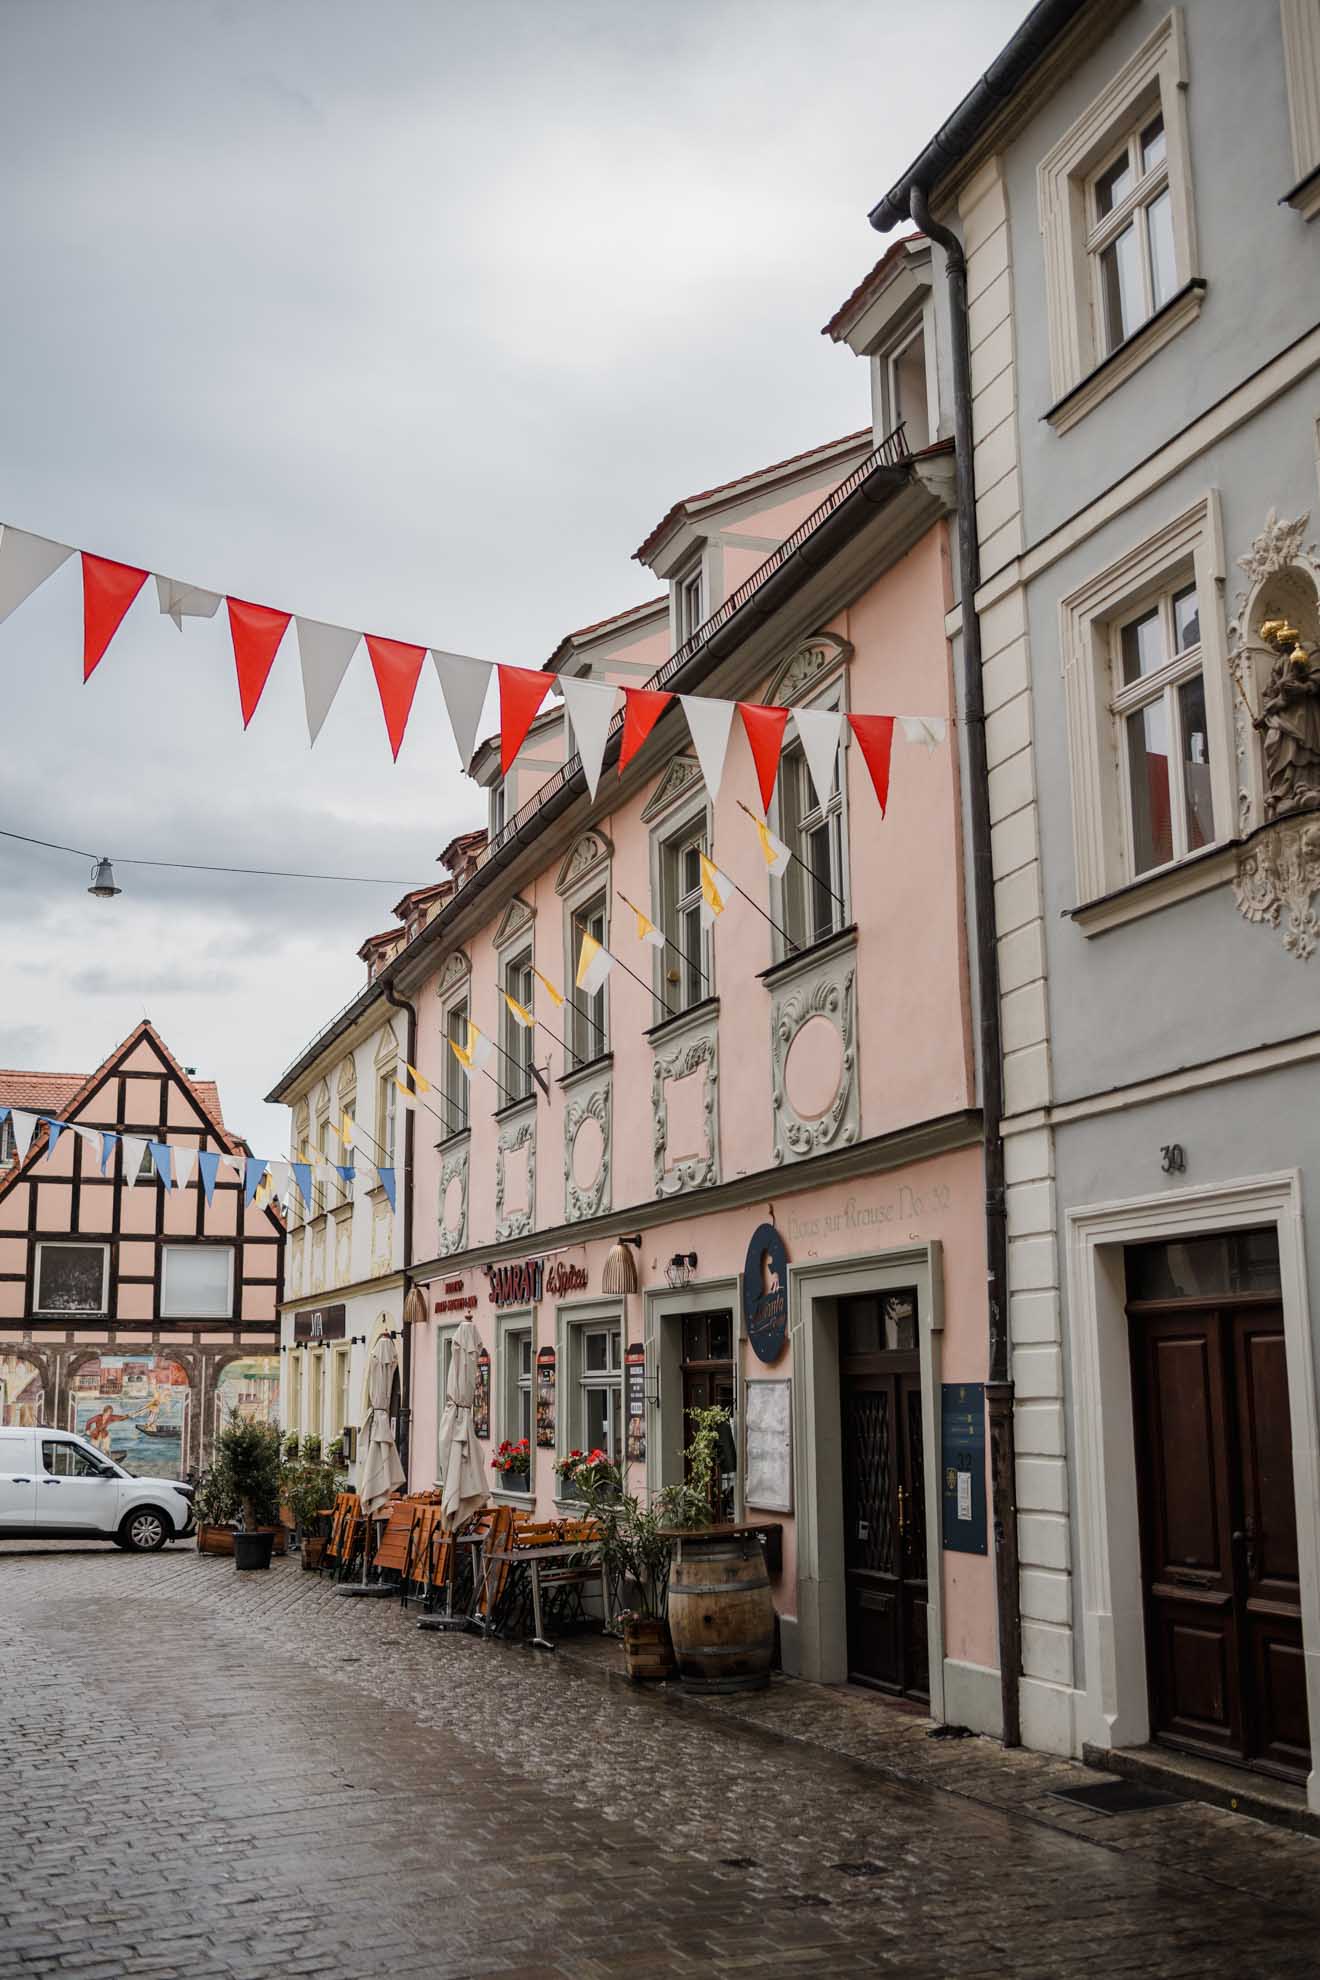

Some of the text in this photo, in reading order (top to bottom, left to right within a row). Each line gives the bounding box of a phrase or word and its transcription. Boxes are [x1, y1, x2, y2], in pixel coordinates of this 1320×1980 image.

[1160, 1144, 1185, 1173] 30
[843, 1197, 894, 1229] Krause
[555, 1261, 588, 1298] Spices
